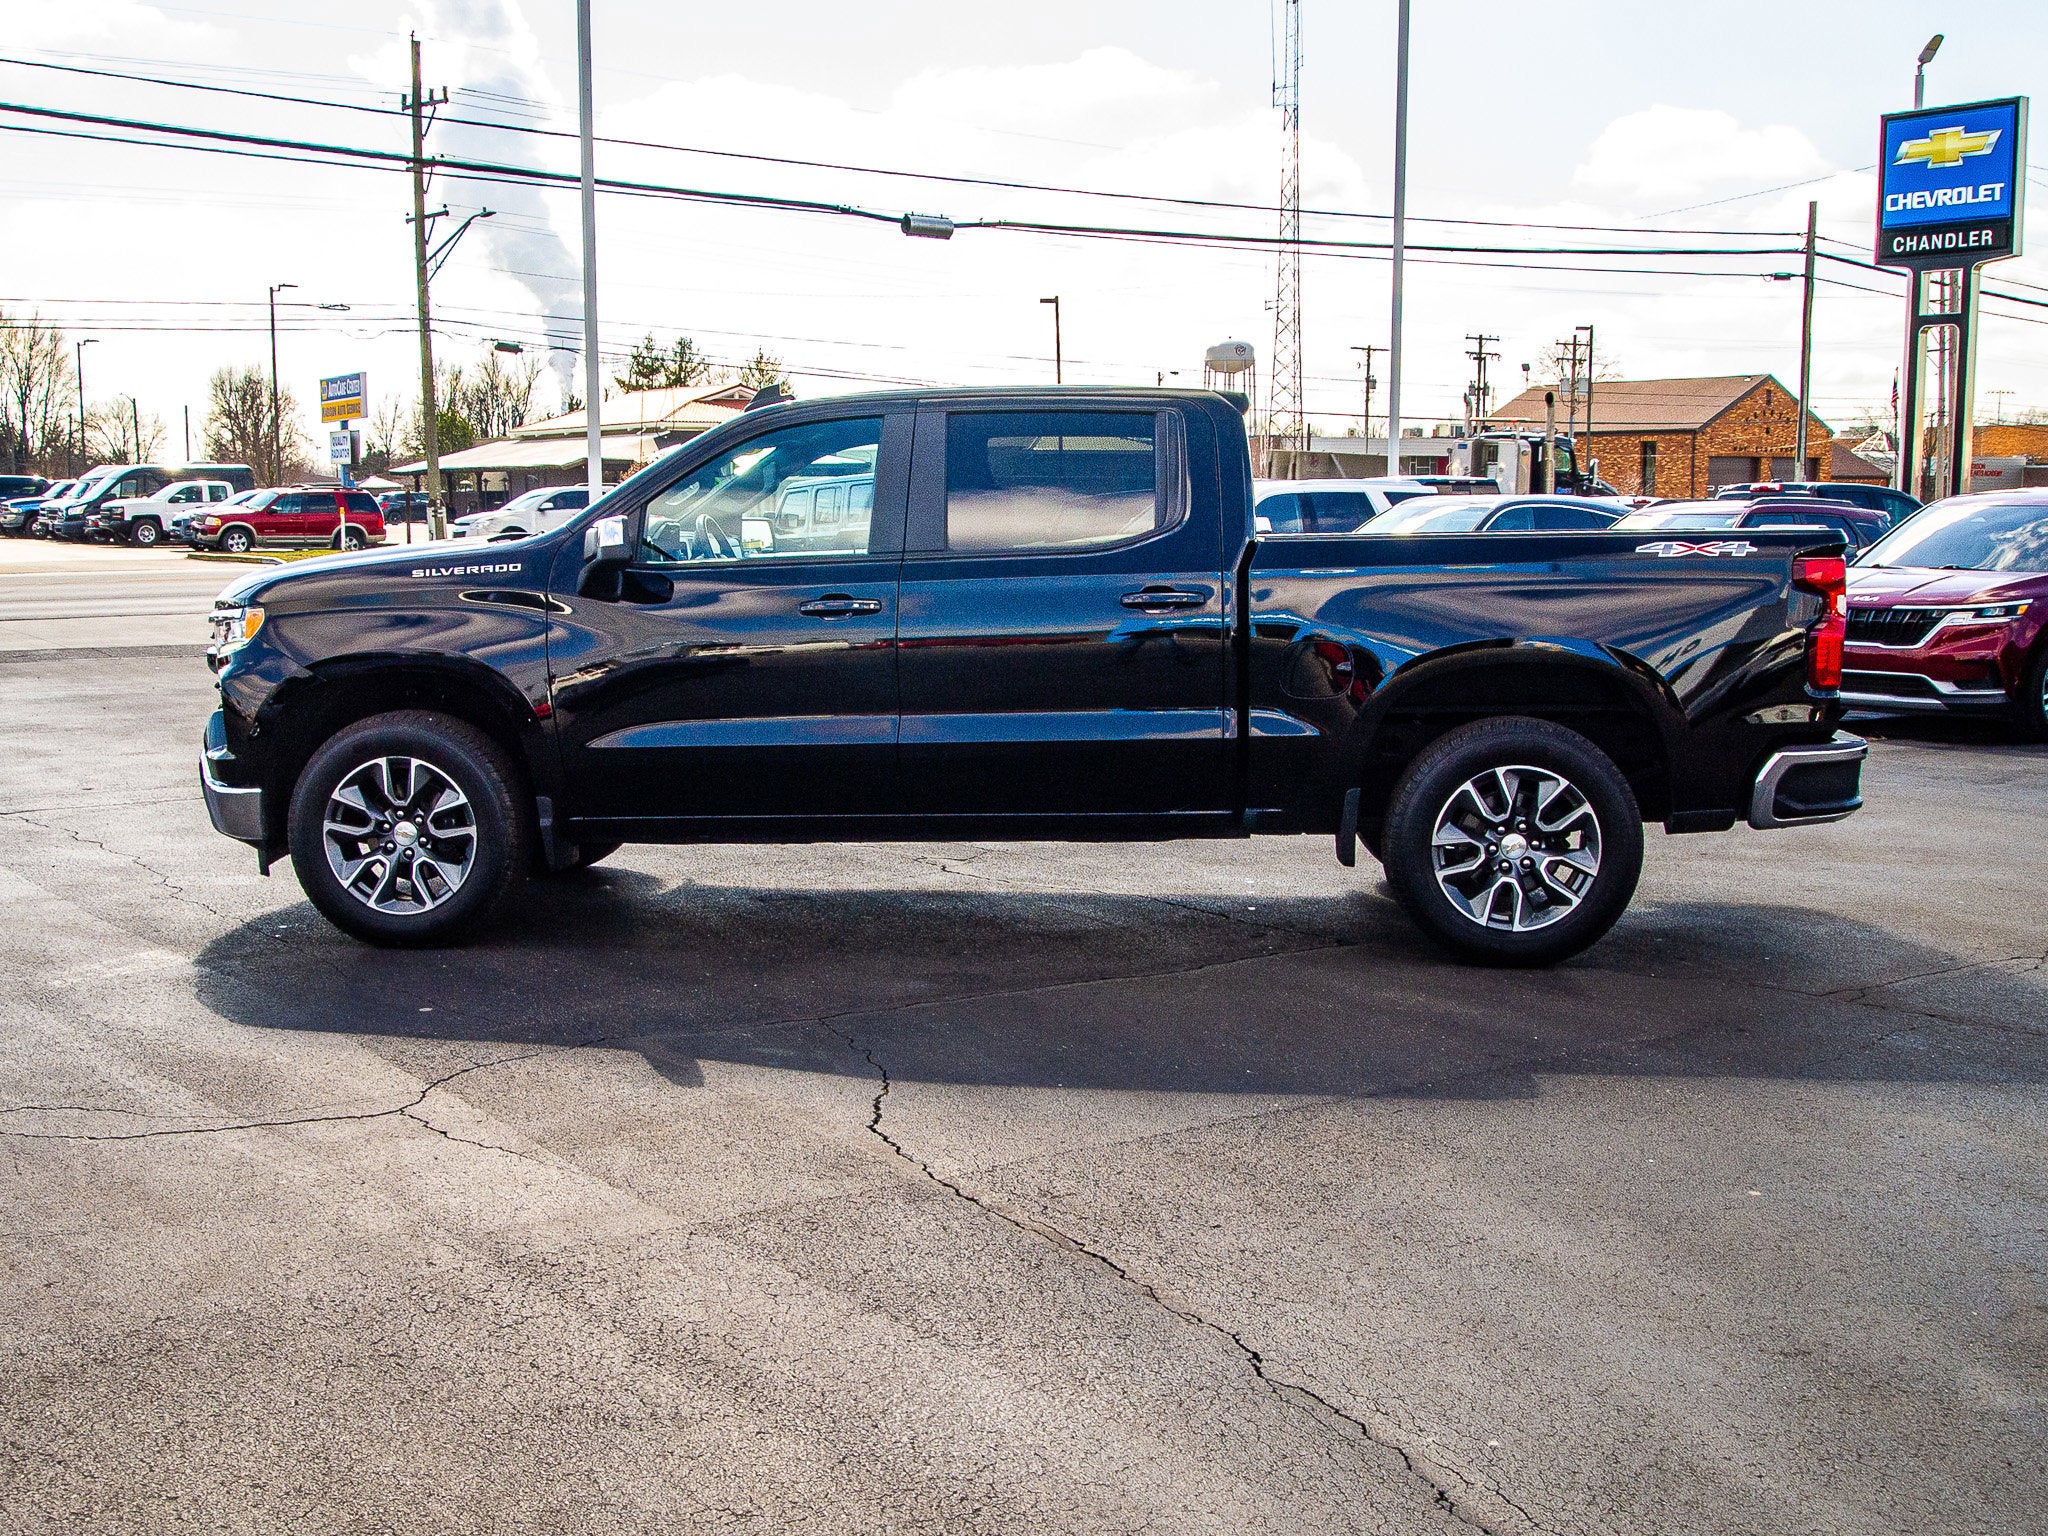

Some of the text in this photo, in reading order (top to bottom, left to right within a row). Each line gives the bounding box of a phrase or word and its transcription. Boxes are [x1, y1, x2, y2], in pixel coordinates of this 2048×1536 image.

[1885, 182, 2005, 212] CHEVROLET
[1892, 229, 1994, 253] CHANDLER
[333, 435, 347, 447] QUALITY
[1635, 541, 1758, 557] 4X4
[411, 563, 522, 578] SILVERADO
